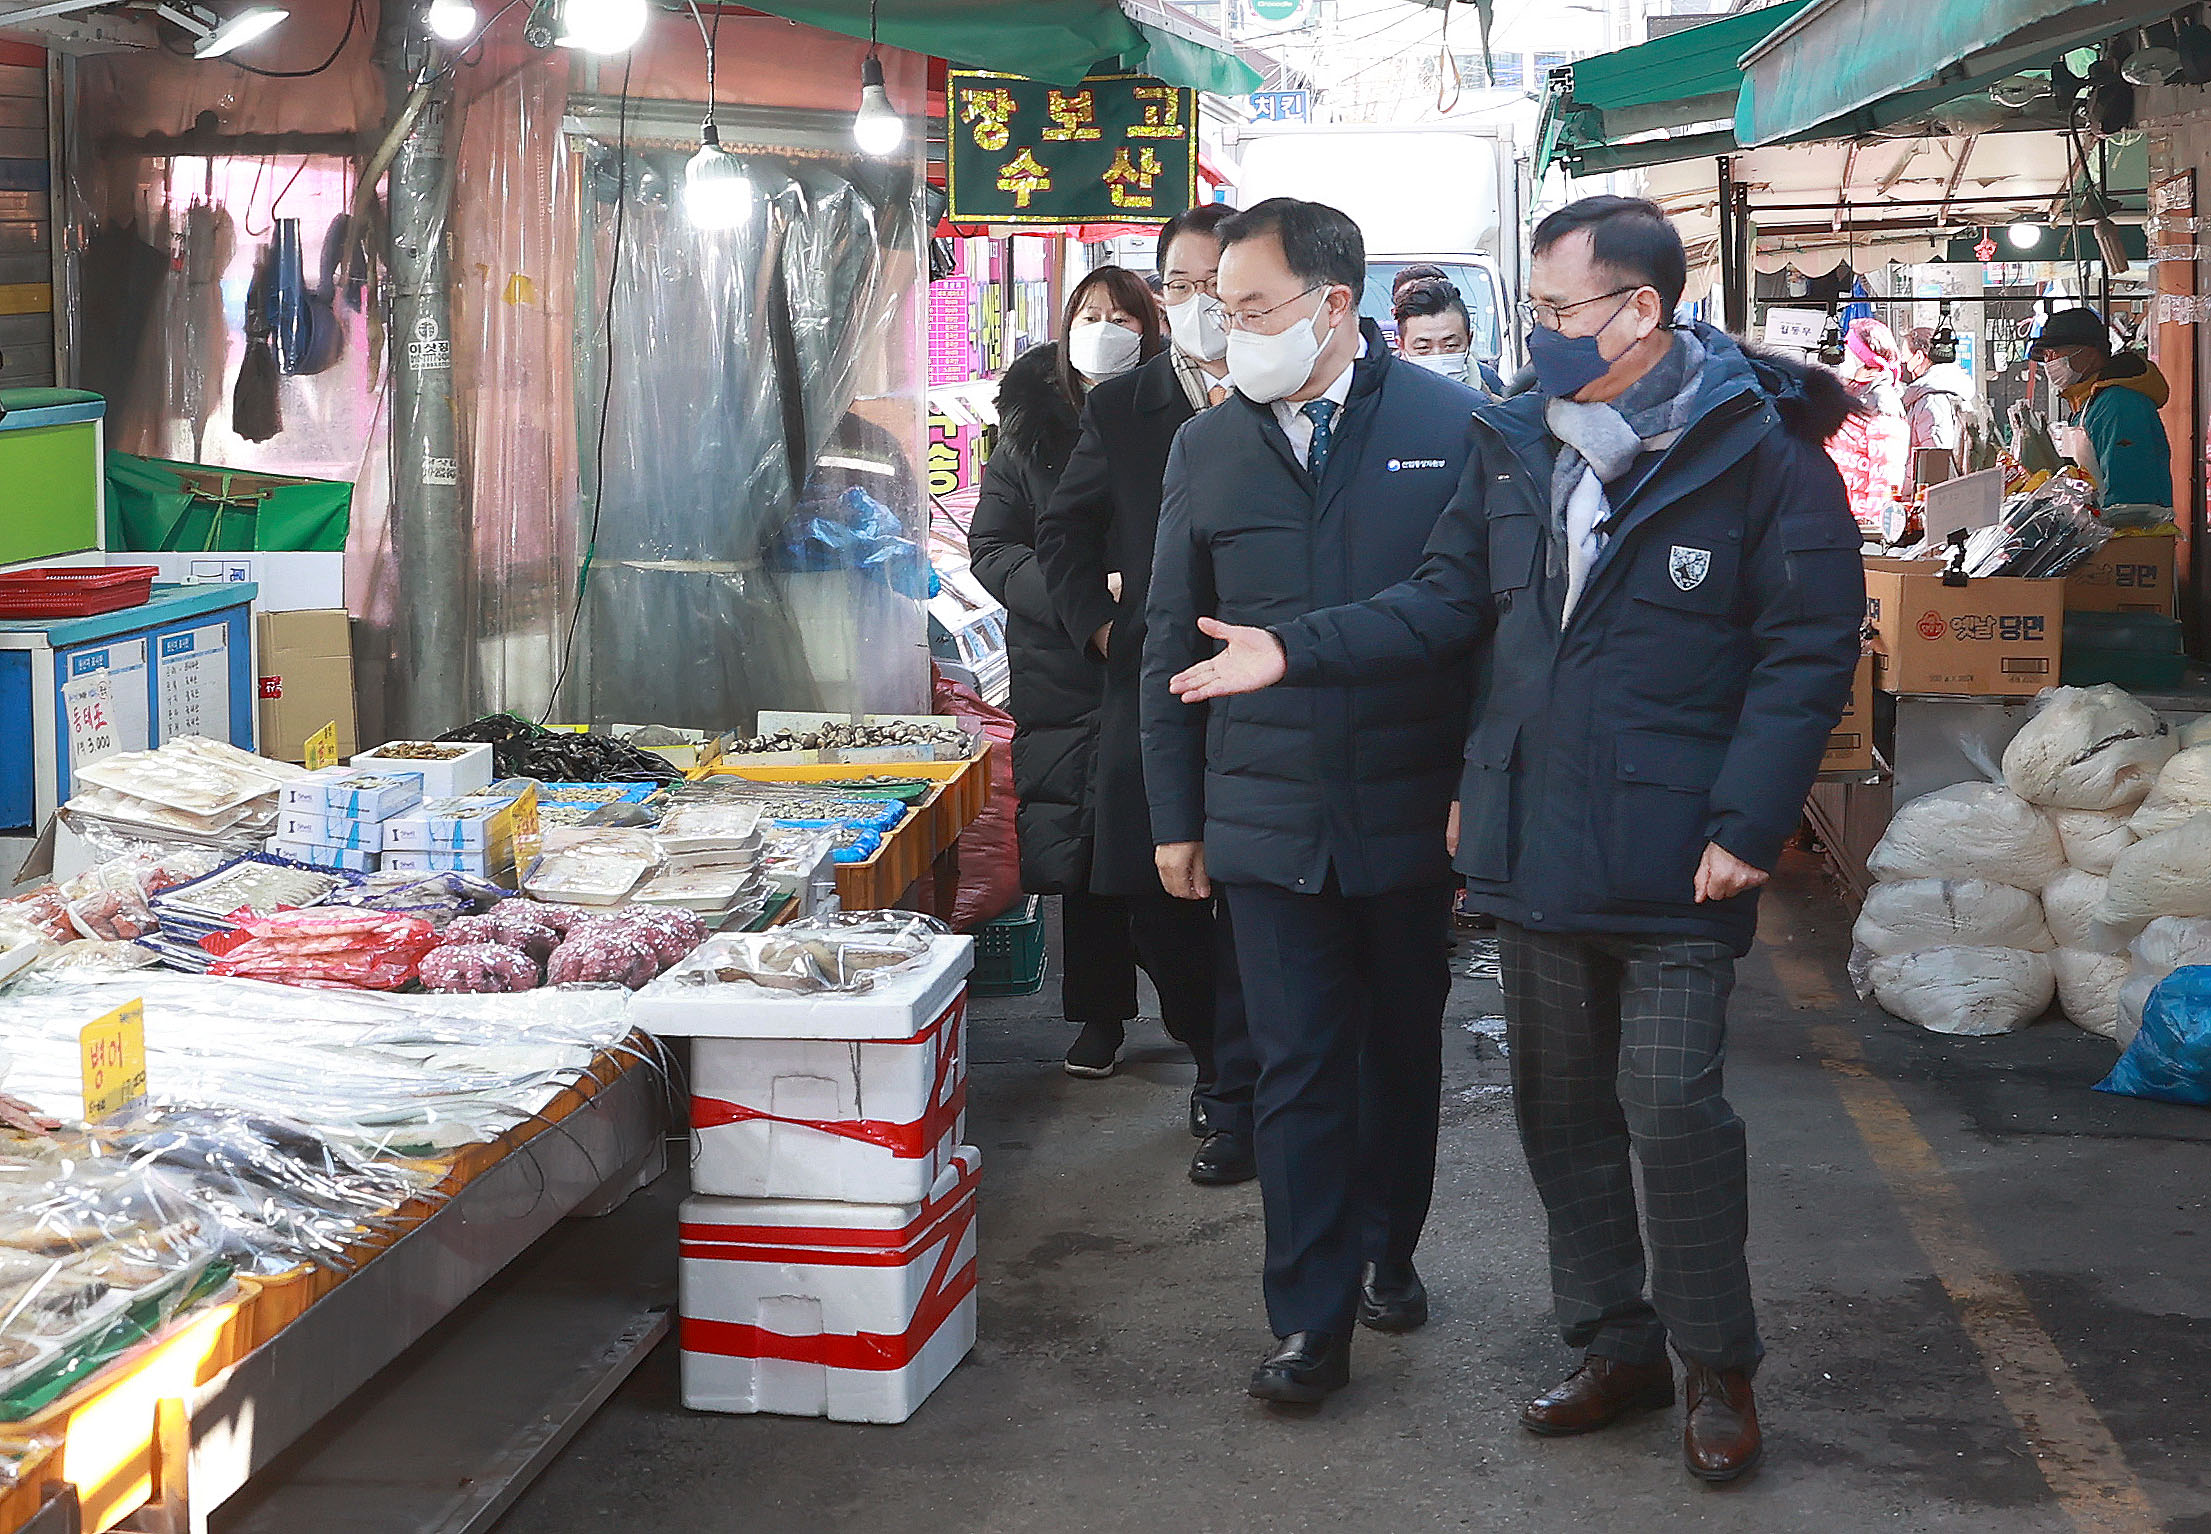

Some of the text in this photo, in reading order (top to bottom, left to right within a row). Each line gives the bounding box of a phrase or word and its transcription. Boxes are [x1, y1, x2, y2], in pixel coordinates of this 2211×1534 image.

[960, 86, 1186, 151] 장보고
[1254, 94, 1304, 121] 치킨
[996, 146, 1163, 209] 수산
[2116, 564, 2157, 588] 당면
[1950, 614, 2044, 641] 옛날 당면
[73, 702, 108, 733] 동태포
[91, 1032, 123, 1089] 병어
